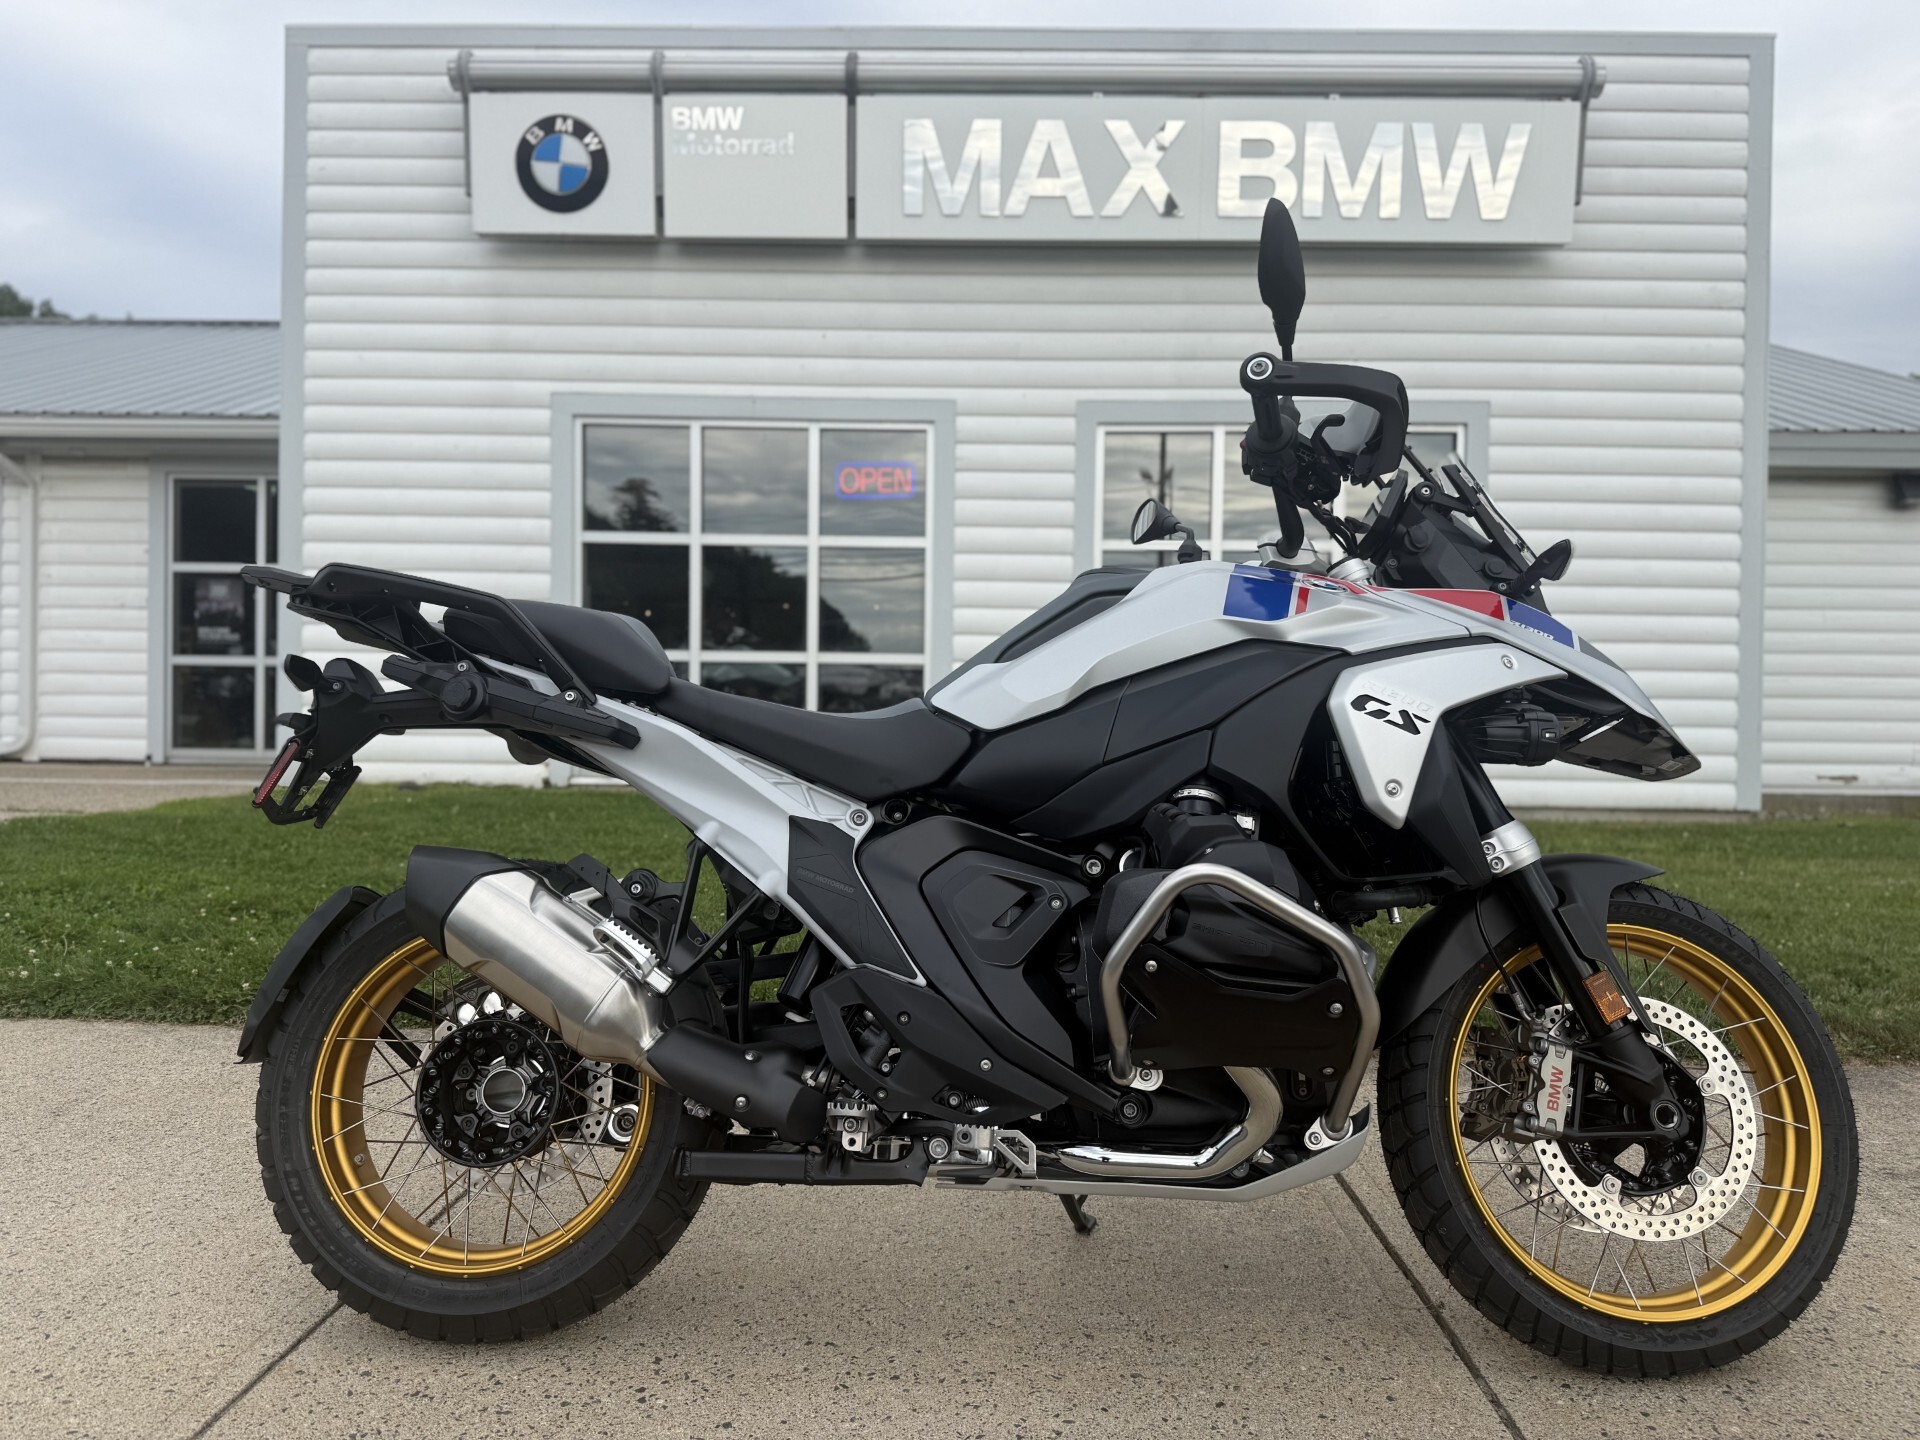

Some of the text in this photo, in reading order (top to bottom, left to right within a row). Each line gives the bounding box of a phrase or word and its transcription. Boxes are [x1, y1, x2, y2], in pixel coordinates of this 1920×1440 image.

[672, 106, 744, 131] BMW
[525, 117, 603, 152] BMW
[672, 132, 794, 155] Motorrad
[903, 118, 1533, 220] MAX BMW
[838, 466, 912, 494] OPEN
[1546, 1065, 1564, 1112] BMW
